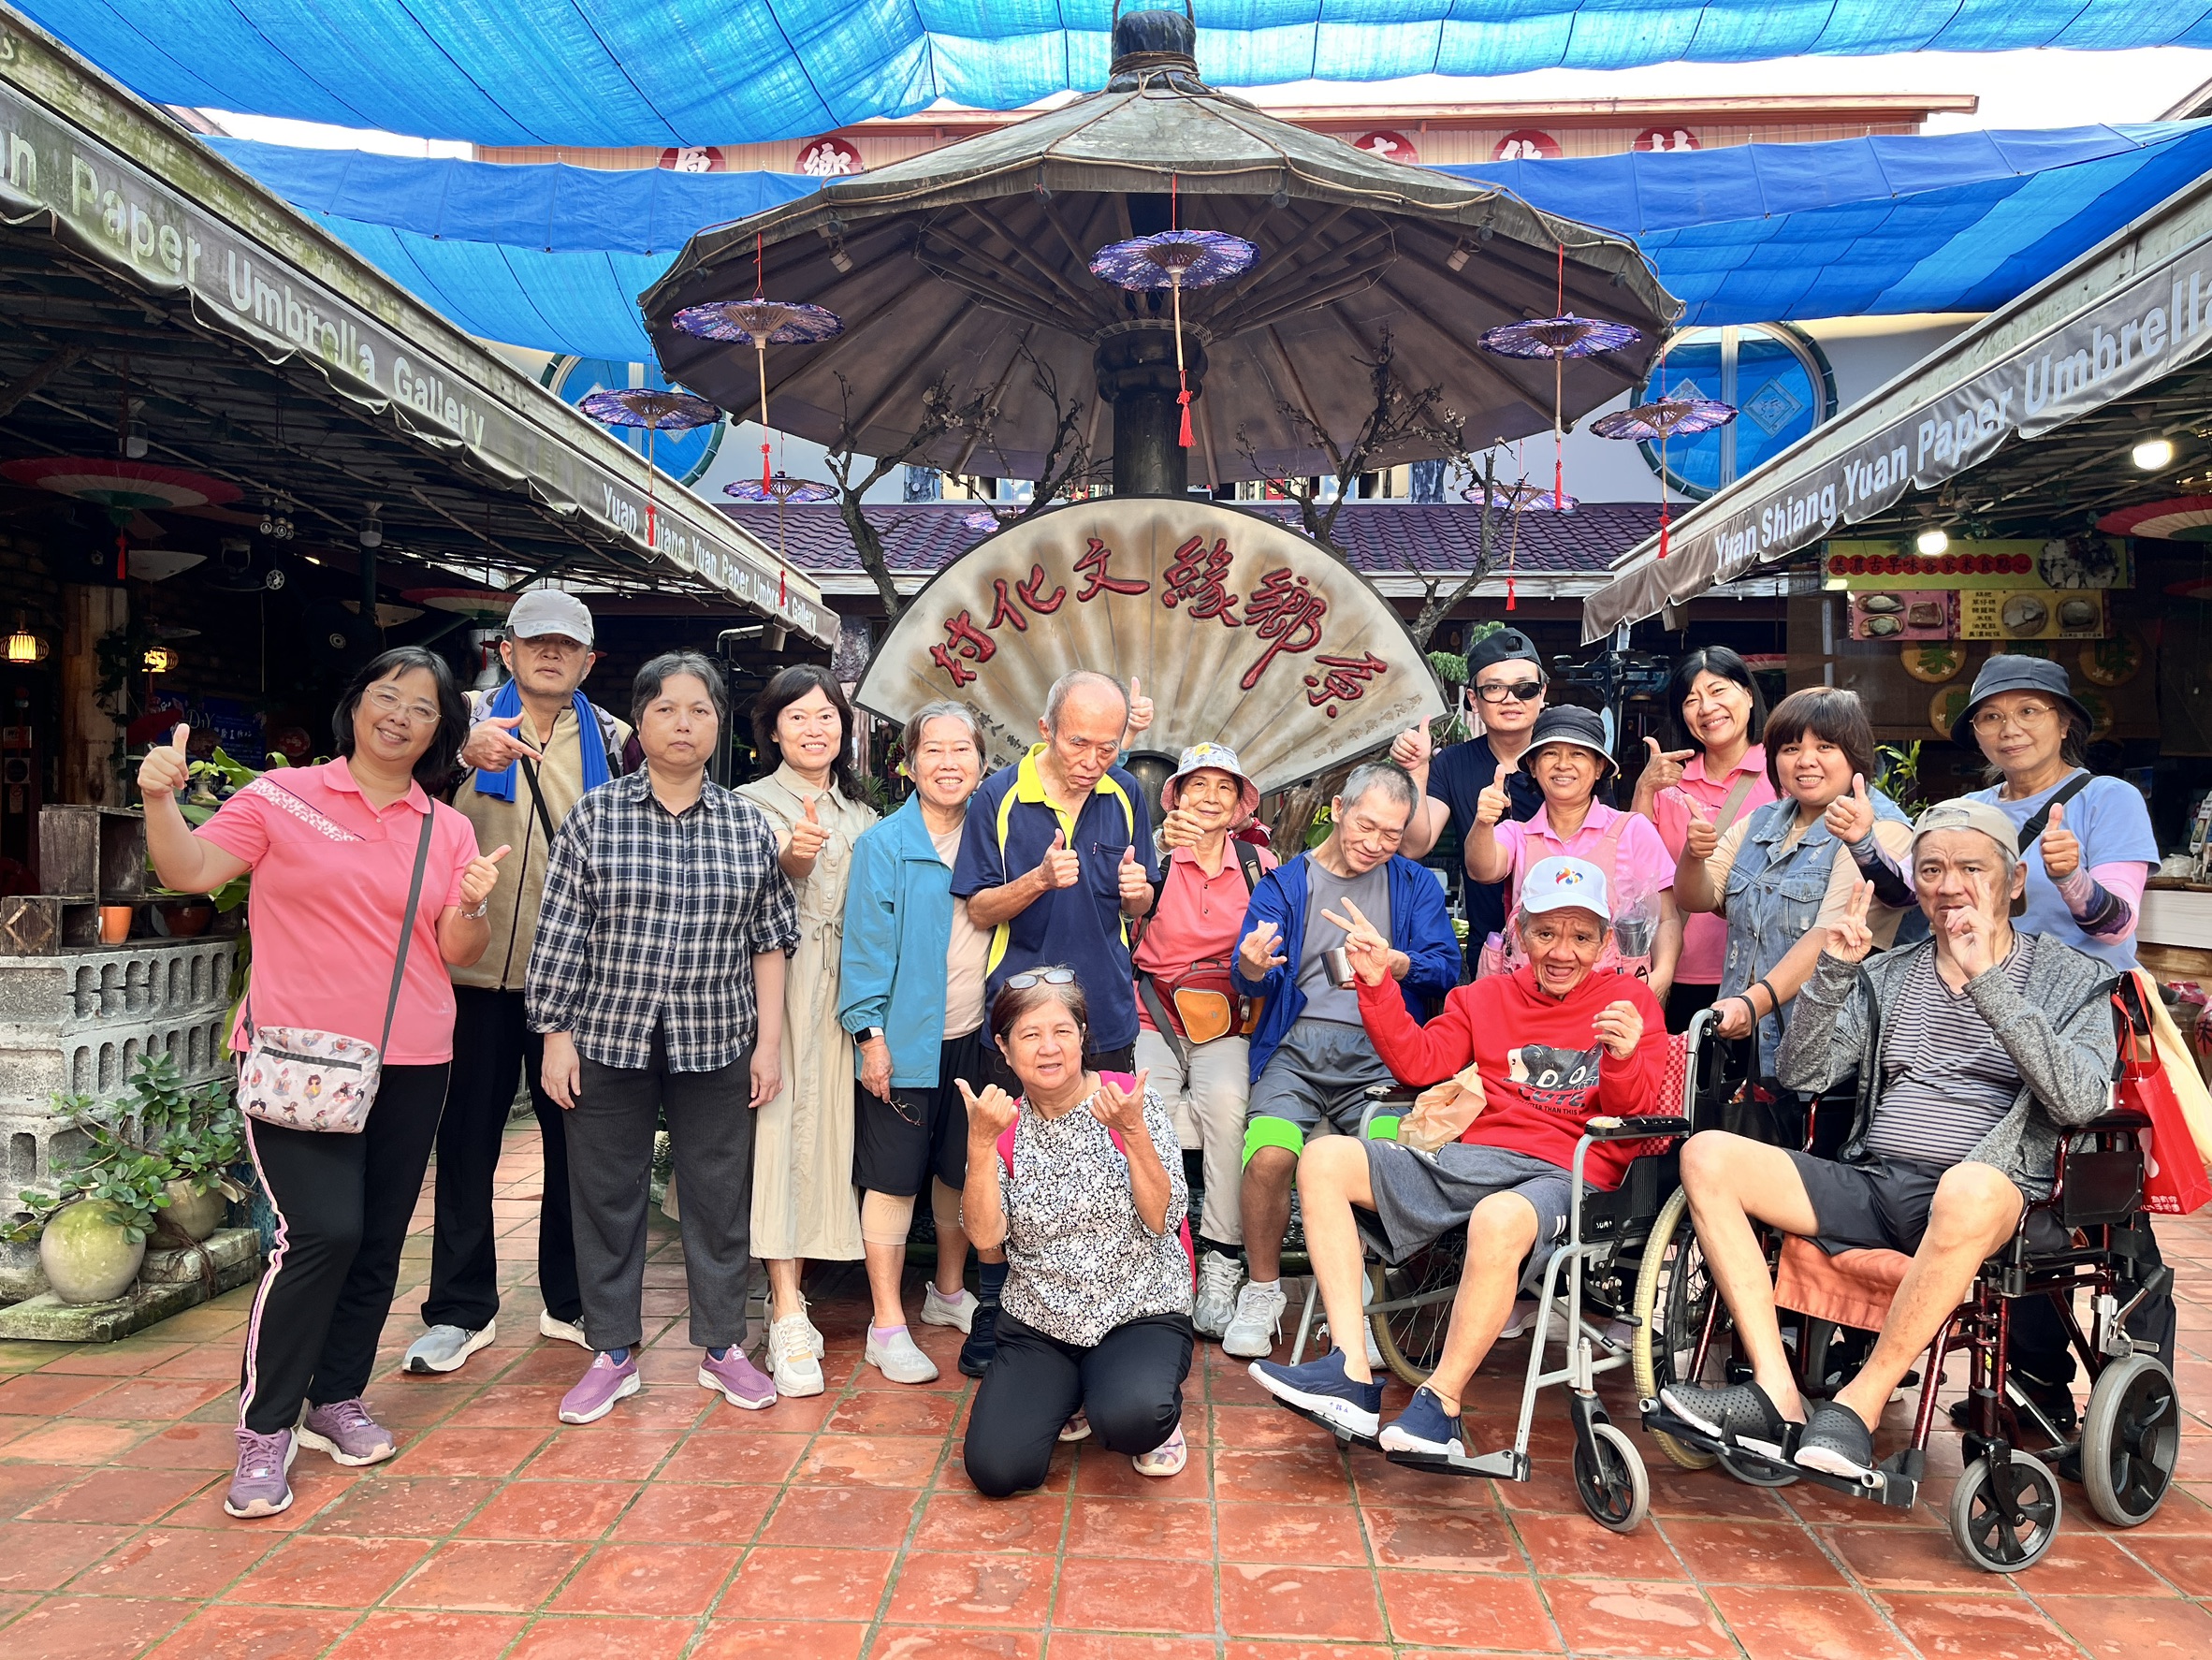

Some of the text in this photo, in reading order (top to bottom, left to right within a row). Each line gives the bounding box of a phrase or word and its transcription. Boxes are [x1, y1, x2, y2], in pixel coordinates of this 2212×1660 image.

[72, 154, 201, 283] Paper
[228, 250, 375, 384] Umbrella
[394, 357, 485, 450] Gallery
[603, 483, 637, 534] Yuan
[691, 535, 717, 578] Yuan
[722, 554, 749, 595] Paper
[754, 573, 789, 616] Umbrea
[792, 596, 817, 635] Gallery
[1714, 524, 1757, 569] Yuan
[1761, 483, 1837, 547] Shiang
[1843, 444, 1909, 506] Yuan
[1917, 386, 2014, 472] Paper
[1544, 1105, 1562, 1114] THAN
